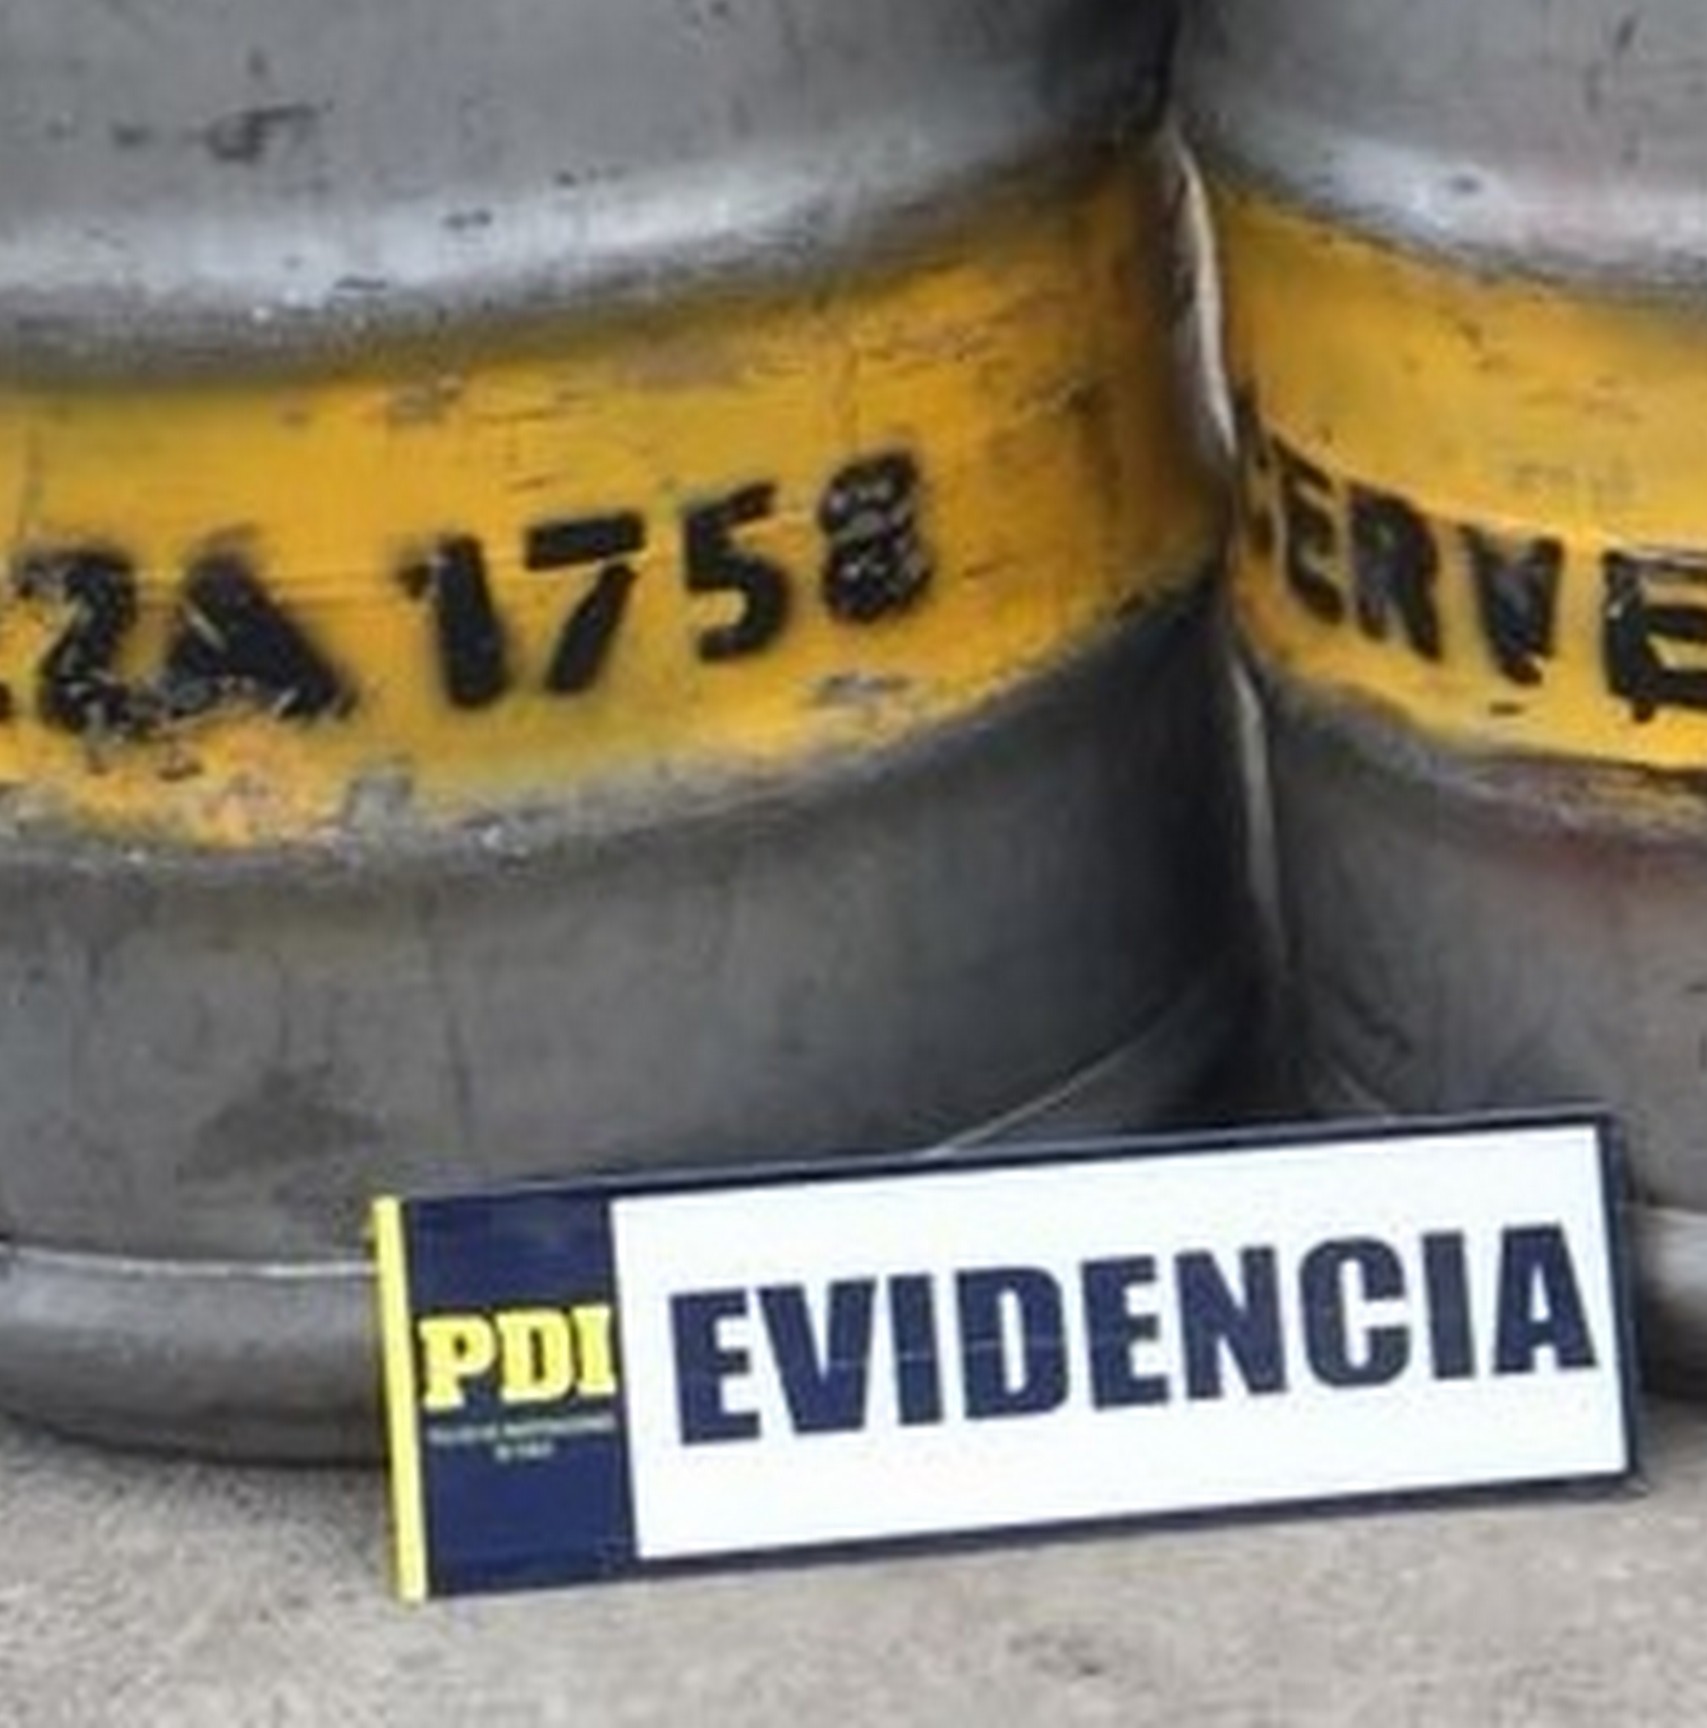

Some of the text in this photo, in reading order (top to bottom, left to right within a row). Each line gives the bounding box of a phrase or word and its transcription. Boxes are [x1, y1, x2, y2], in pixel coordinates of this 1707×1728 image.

[0, 450, 934, 738] ZA 1758
[418, 1304, 617, 1412] PDI
[668, 1222, 1599, 1447] EVIDENCIA
